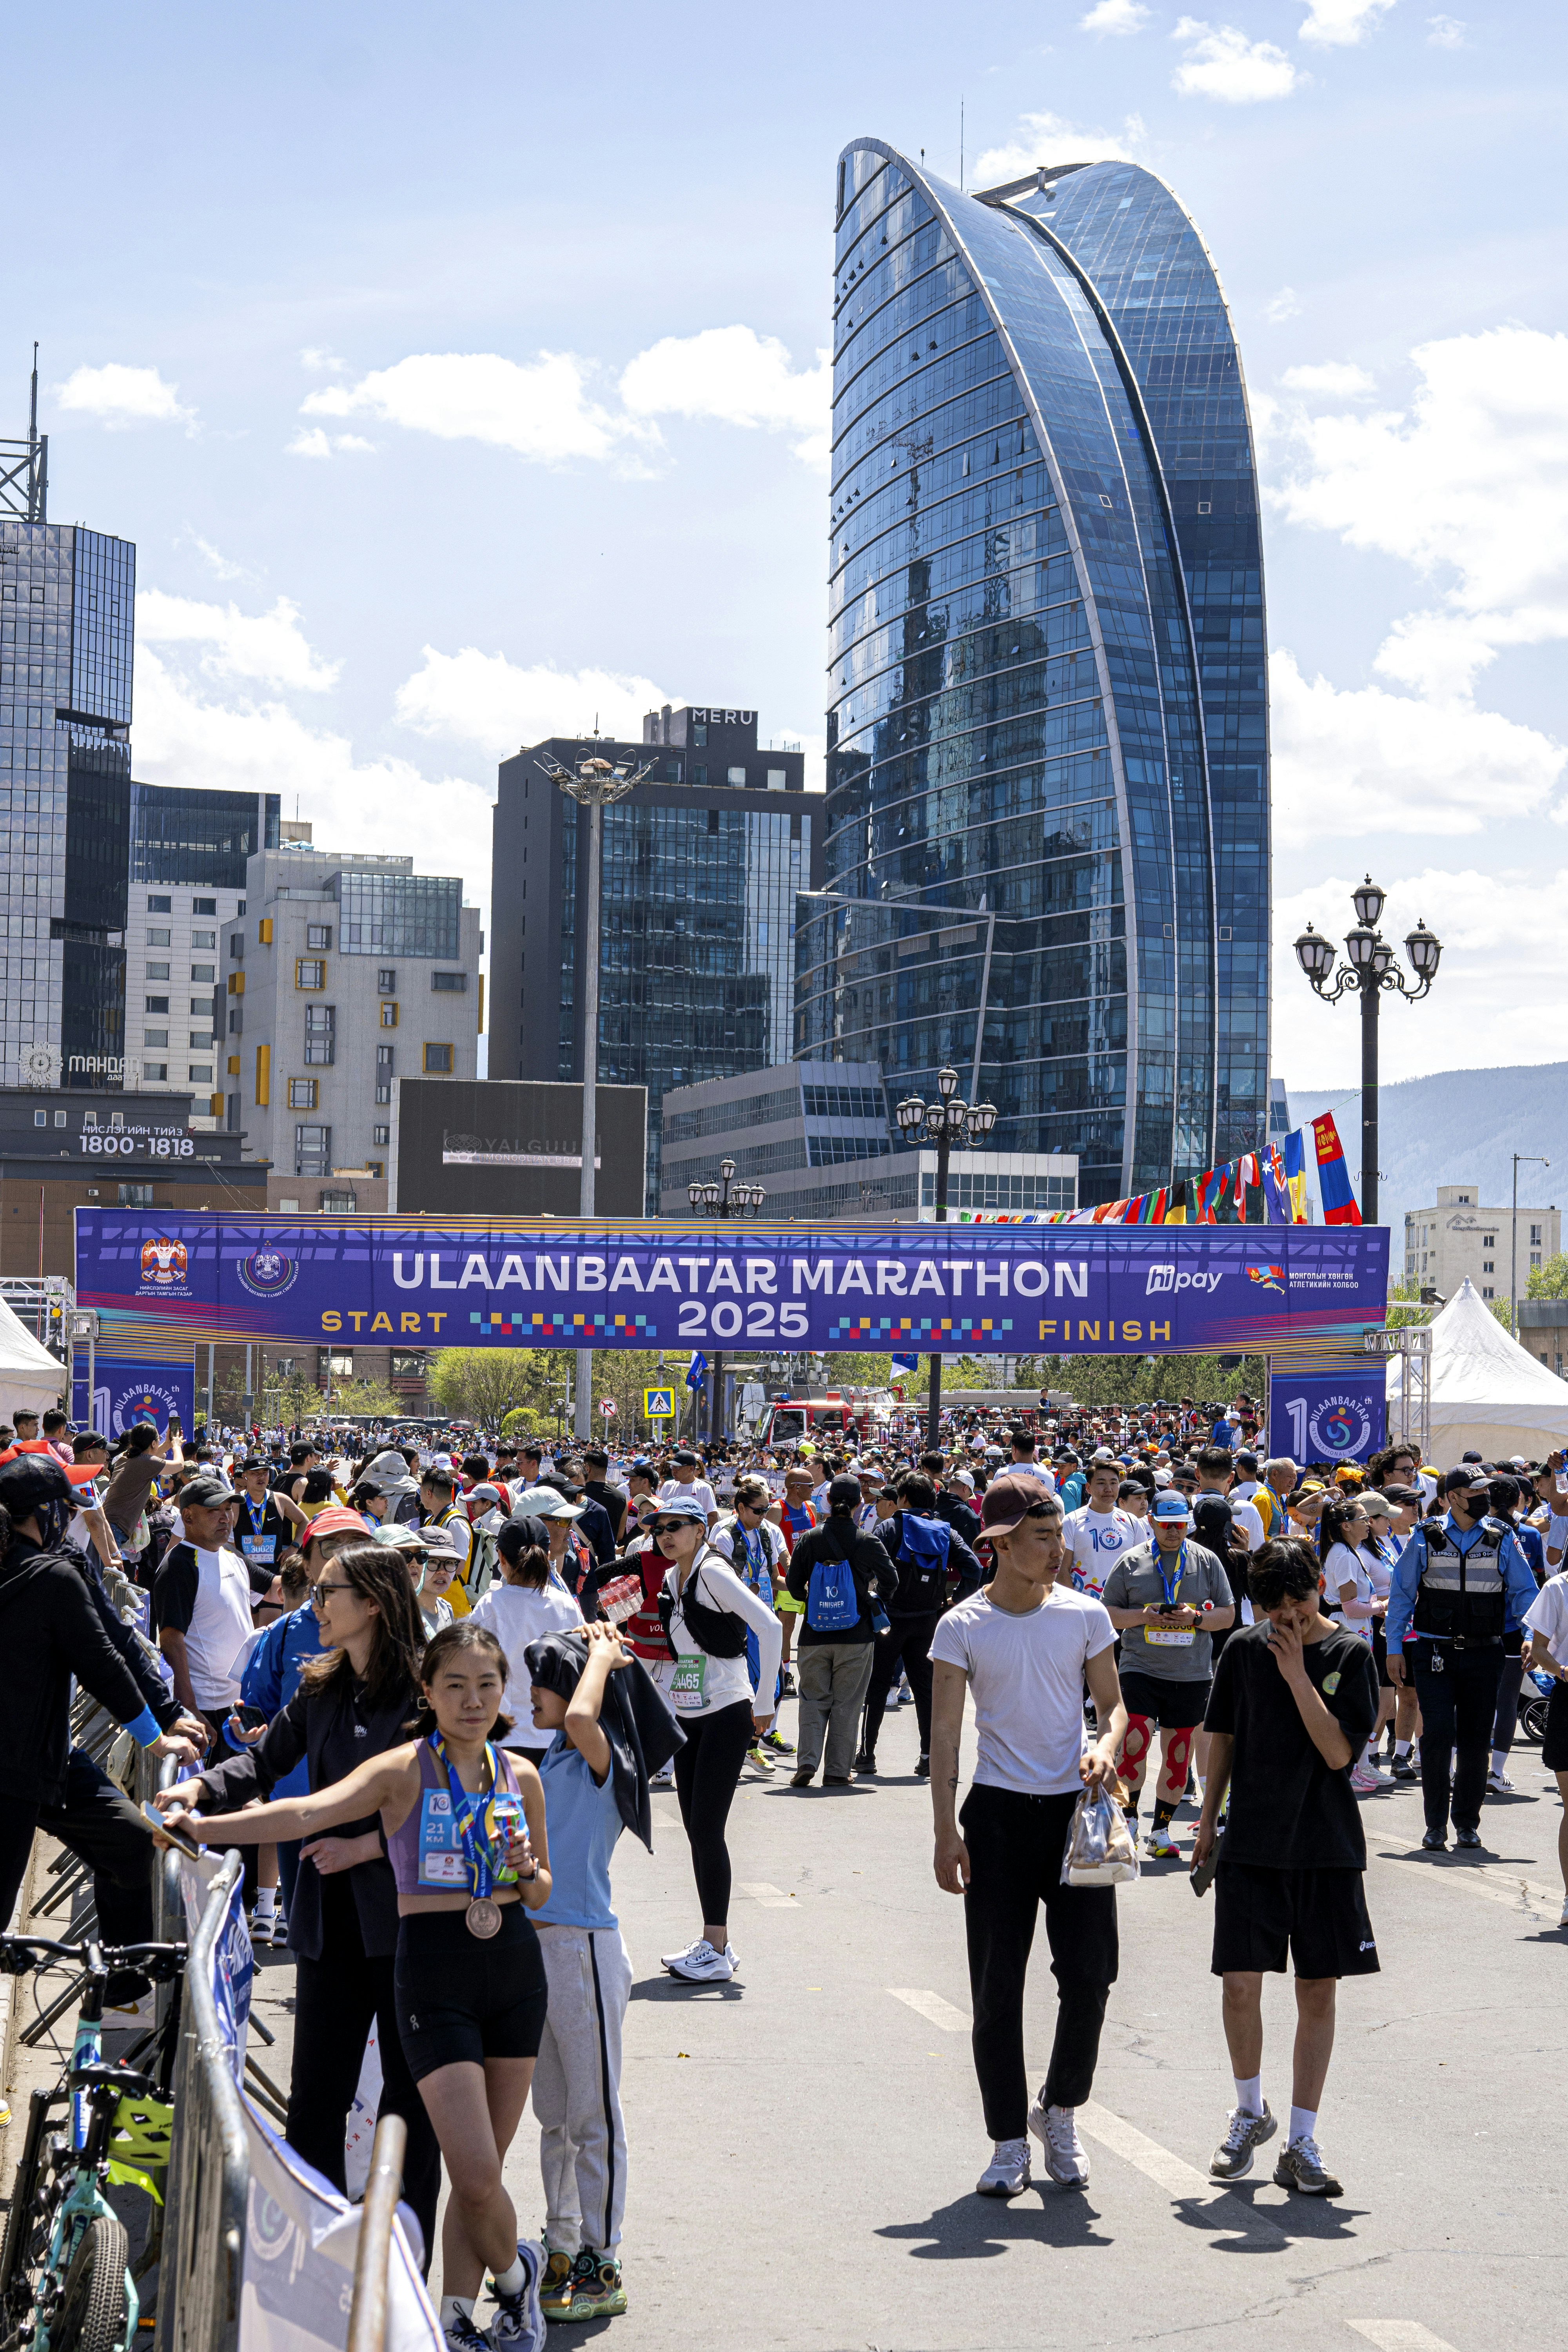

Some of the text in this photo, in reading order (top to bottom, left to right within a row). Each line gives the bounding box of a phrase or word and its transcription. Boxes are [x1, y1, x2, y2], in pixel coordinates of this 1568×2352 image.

[693, 708, 752, 725] MERU
[83, 1125, 183, 1136] НИСЛЭГИЙН ТИЙЗ
[486, 1154, 550, 1163] MONGOLIAN
[283, 1274, 298, 1293] СПОРТЫН
[393, 1253, 1088, 1297] ULAANBAATAR MARATHON
[322, 1310, 447, 1333] START
[678, 1301, 808, 1337] 2025
[1039, 1320, 1170, 1341] FINISH
[114, 1384, 176, 1410] ULAANBAATAR
[1311, 1396, 1369, 1421] ULAANBAATAR
[1312, 1425, 1368, 1456] INTERNATIONAL MARATHON
[1099, 1527, 1121, 1537] ULAANBAATAR
[650, 1624, 664, 1632] VOL
[675, 1673, 699, 1689] 4465
[426, 1822, 445, 1835] 21
